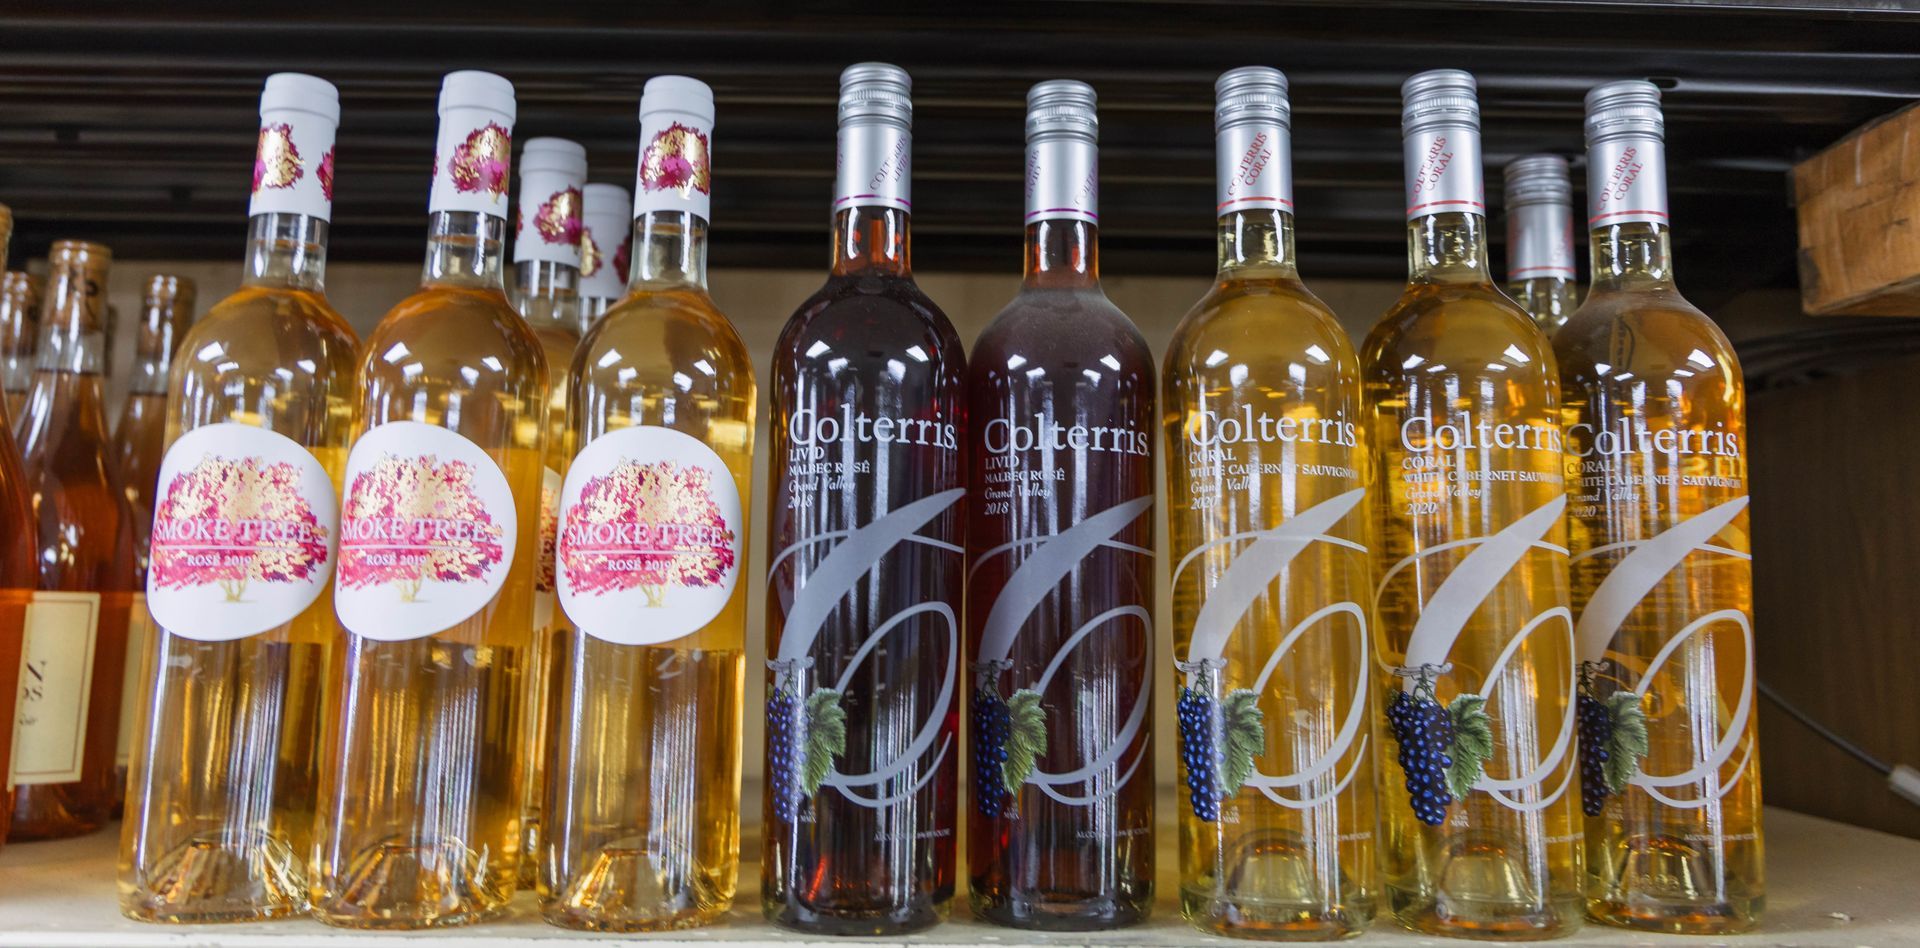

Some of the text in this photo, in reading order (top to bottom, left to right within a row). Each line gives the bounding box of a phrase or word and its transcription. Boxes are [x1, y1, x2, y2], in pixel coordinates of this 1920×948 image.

[1614, 163, 1643, 201] CORAL
[985, 454, 1020, 470] LIVID
[1402, 454, 1456, 470] CORAL
[984, 470, 1028, 484] MALBEC
[984, 485, 1013, 500] Grand
[984, 501, 1009, 516] 2018
[1406, 502, 1437, 516] 2020
[154, 518, 312, 543] SMOKE TREE
[341, 517, 487, 543] SMOKE TREE
[567, 523, 724, 548] SMOKE TREE
[224, 555, 251, 567] 2019
[400, 555, 427, 566] 2019
[607, 558, 673, 572] ROSÉ 2019
